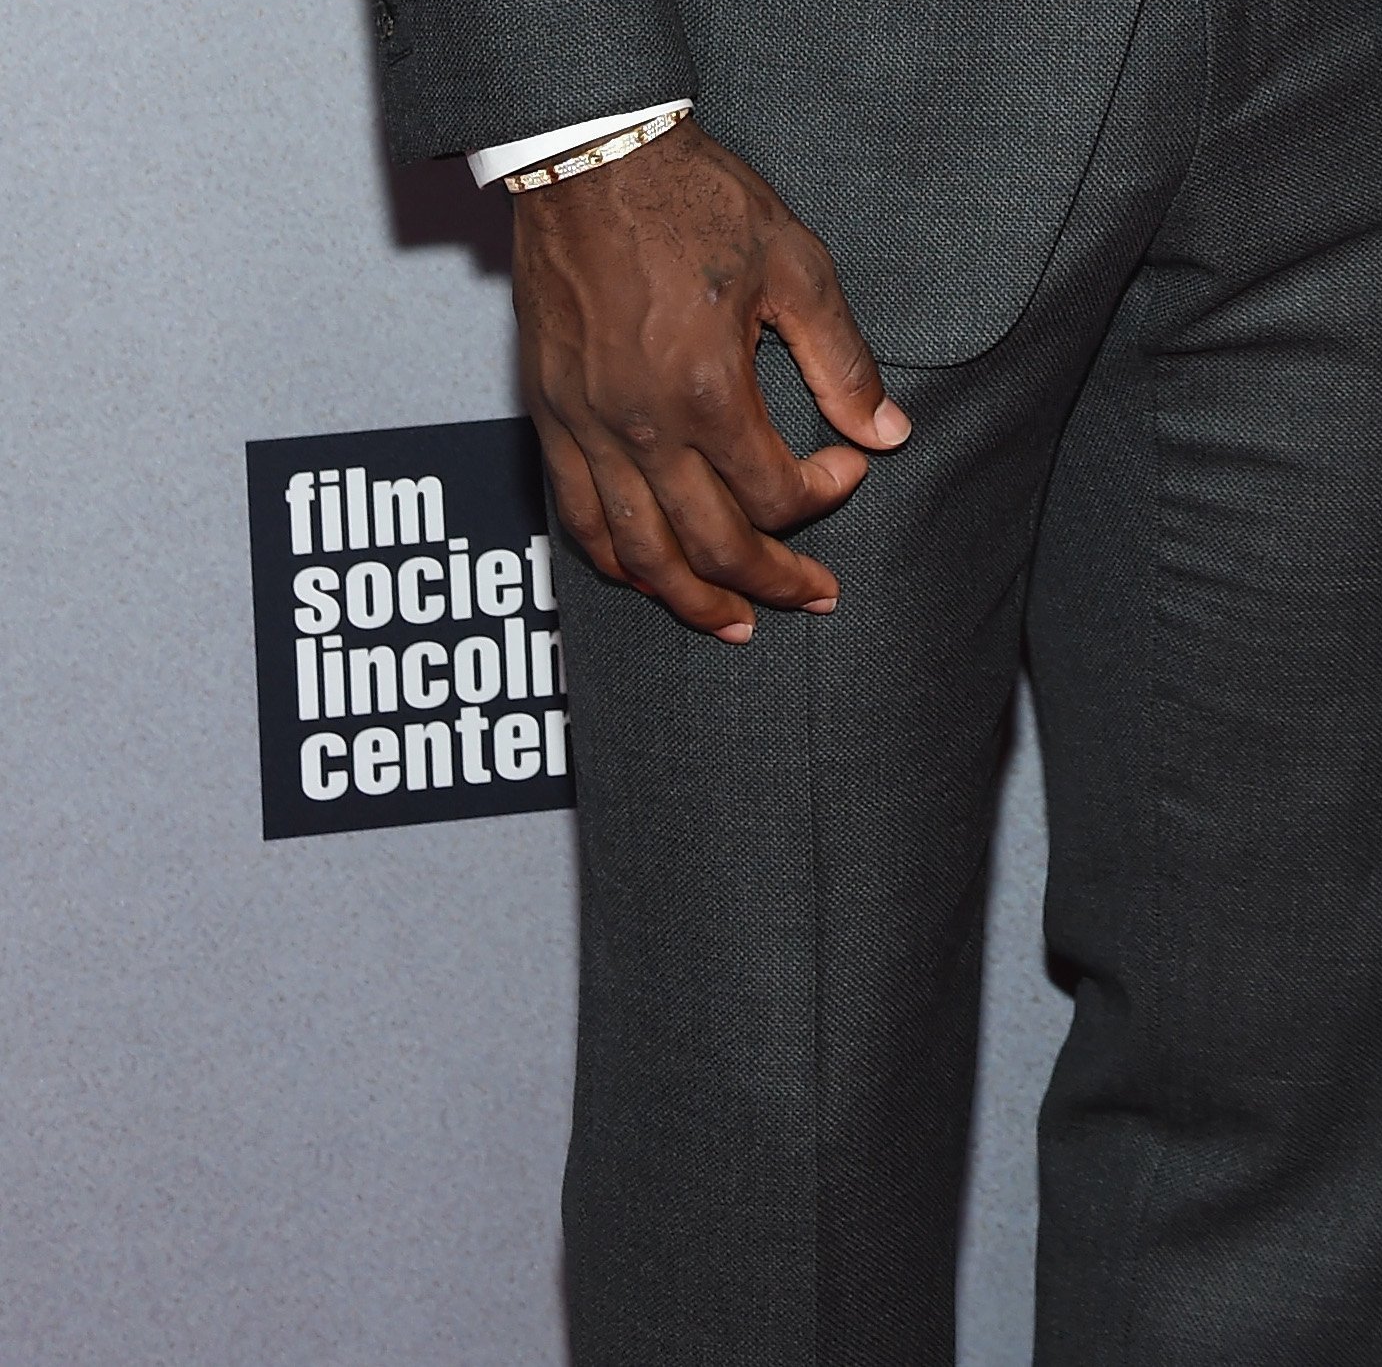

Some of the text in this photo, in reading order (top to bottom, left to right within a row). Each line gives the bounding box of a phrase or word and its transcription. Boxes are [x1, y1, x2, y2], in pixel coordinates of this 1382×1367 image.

[285, 467, 445, 555] film
[293, 534, 559, 634] societ
[295, 617, 568, 721] lincoln
[300, 705, 572, 801] center
